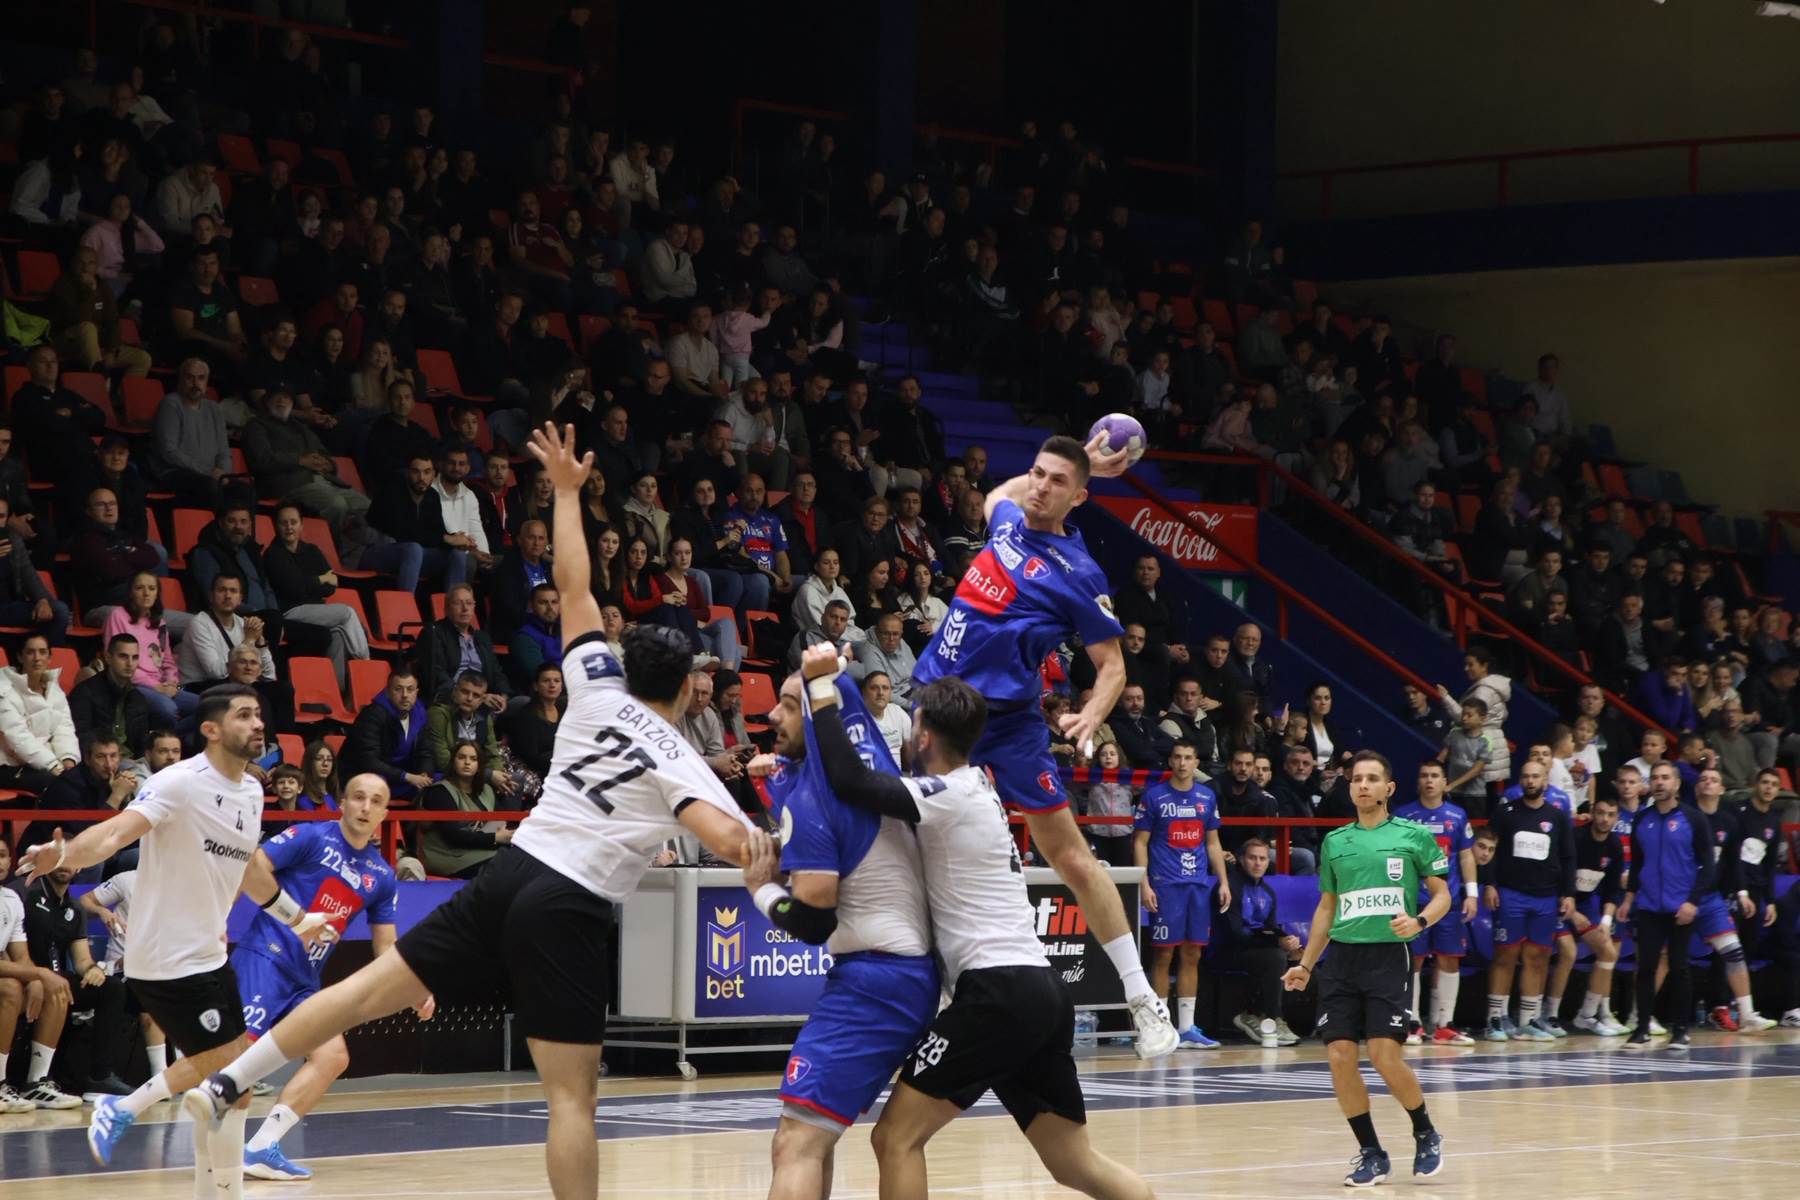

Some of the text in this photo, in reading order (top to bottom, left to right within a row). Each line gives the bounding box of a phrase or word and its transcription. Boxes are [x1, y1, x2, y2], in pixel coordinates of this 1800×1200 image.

[963, 564, 1008, 602] m:tel
[938, 643, 958, 662] bet
[616, 703, 682, 761] BATZIOS
[559, 726, 658, 816] 22
[236, 810, 243, 832] 4
[1160, 802, 1176, 818] 20
[1172, 828, 1200, 841] m:tel
[320, 845, 343, 873] 22
[319, 893, 352, 919] m:tel
[1357, 894, 1402, 910] DEKRA
[765, 930, 798, 943] OSJE
[1152, 925, 1168, 940] 20
[1044, 941, 1085, 956] nLine
[751, 947, 834, 977] mbet.b
[706, 975, 744, 999] bet
[243, 1005, 266, 1030] 22
[917, 1031, 950, 1066] 28
